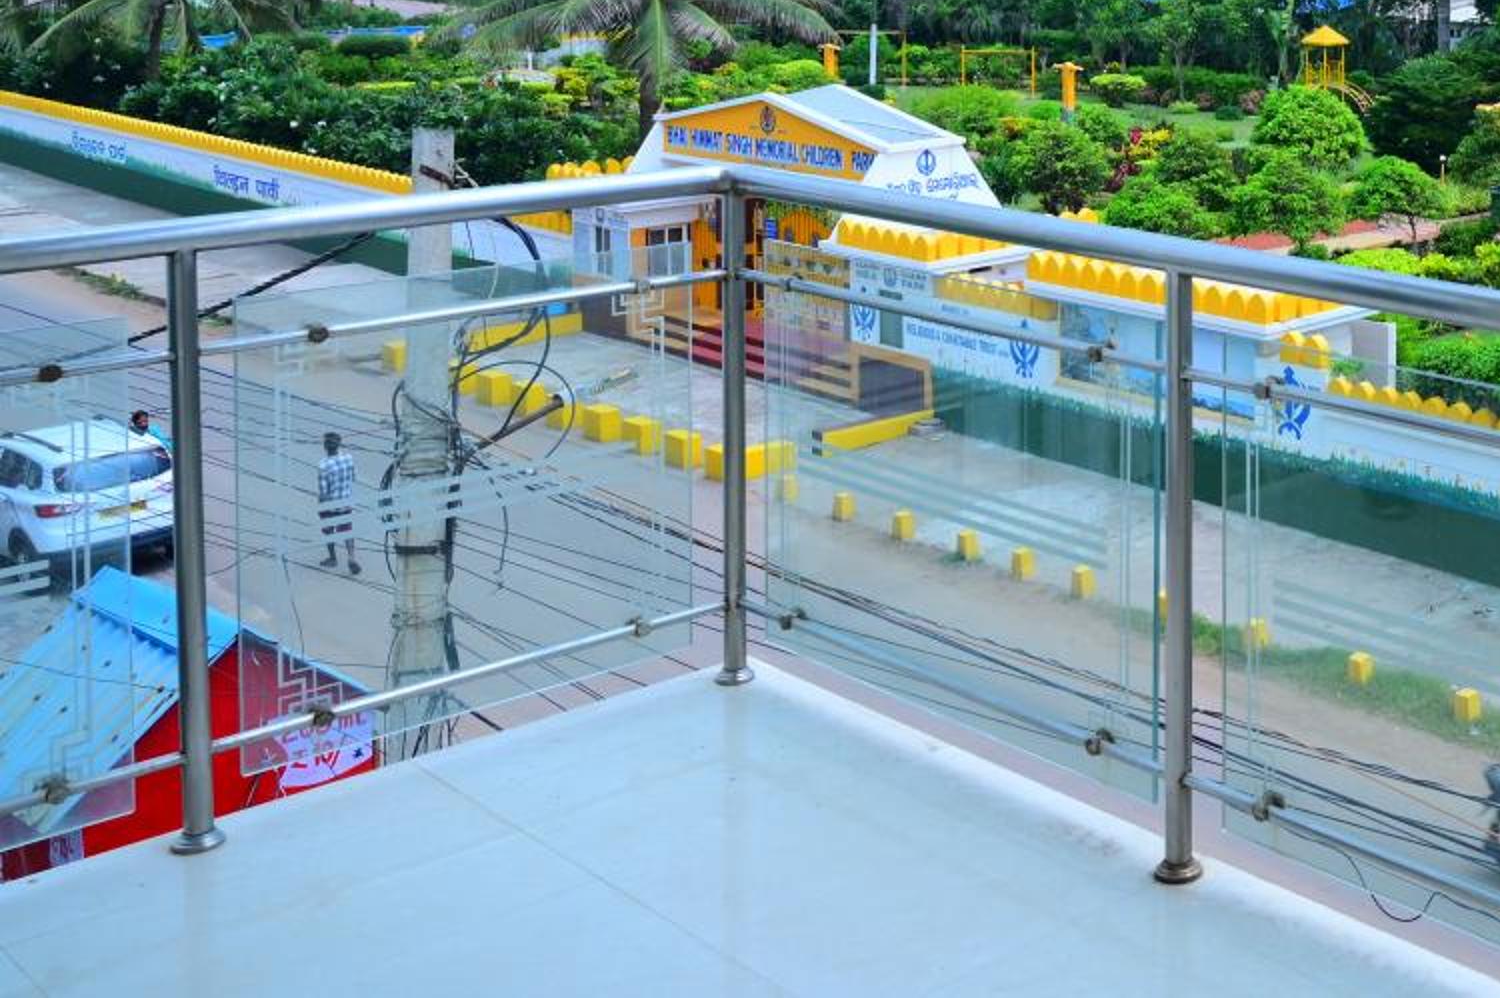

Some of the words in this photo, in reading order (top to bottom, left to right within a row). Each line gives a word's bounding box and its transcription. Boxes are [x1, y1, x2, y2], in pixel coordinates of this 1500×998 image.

[726, 133, 753, 155] SINGH
[755, 138, 800, 163] MEMORIAL
[801, 144, 845, 170] CHILDREN
